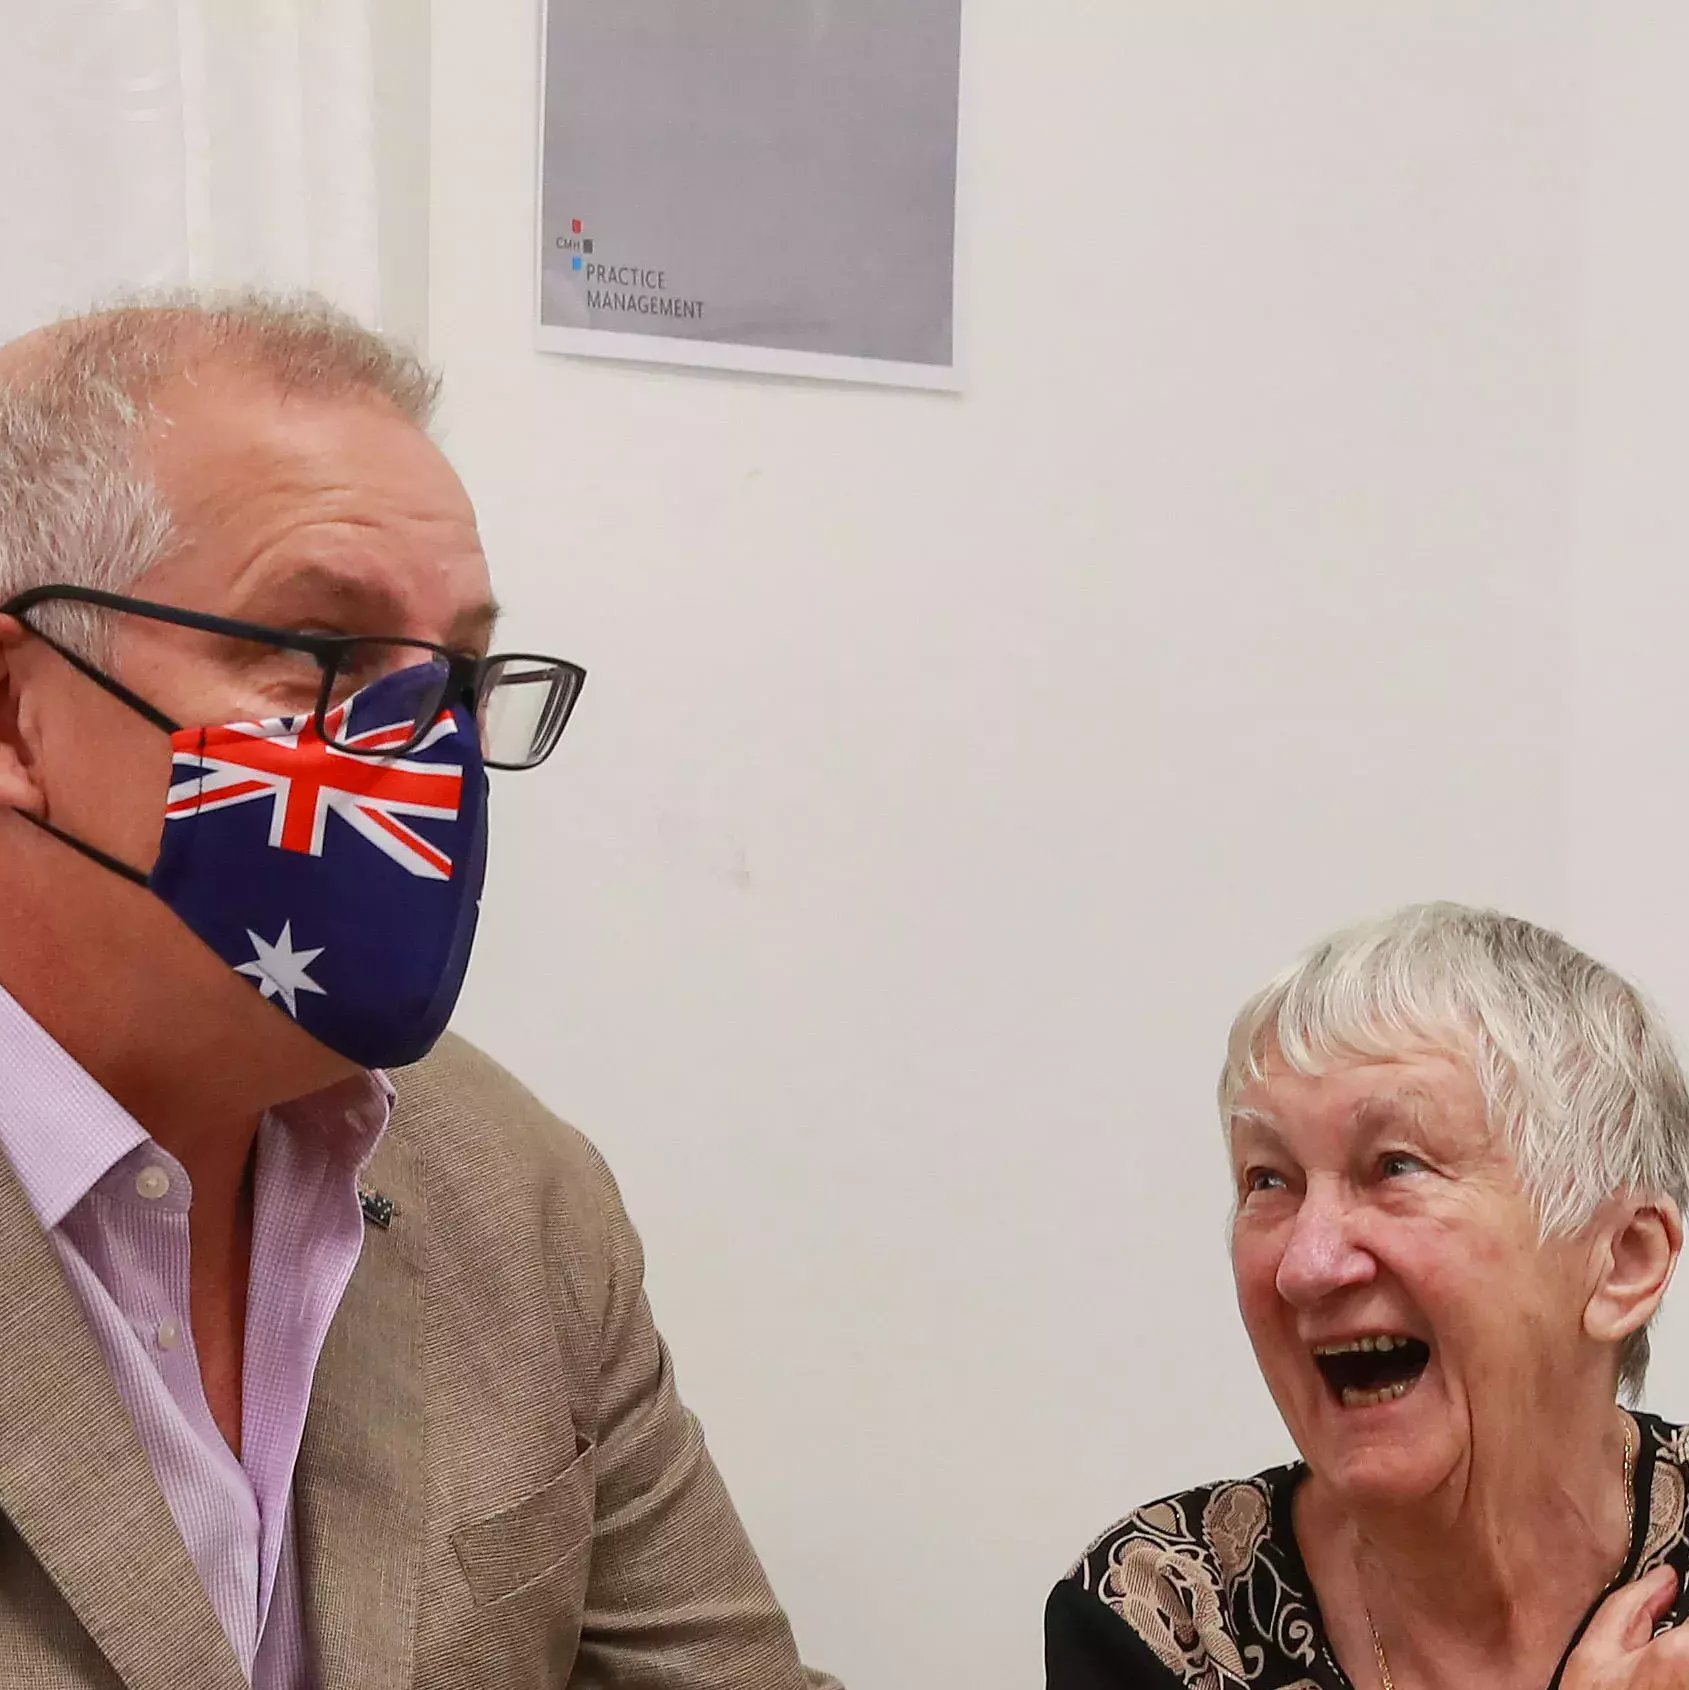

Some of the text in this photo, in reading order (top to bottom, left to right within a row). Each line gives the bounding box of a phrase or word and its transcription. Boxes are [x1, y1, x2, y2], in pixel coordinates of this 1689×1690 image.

[556, 237, 580, 250] CMH
[586, 263, 666, 290] PRACTICE
[586, 290, 704, 318] MANAGEMENT
